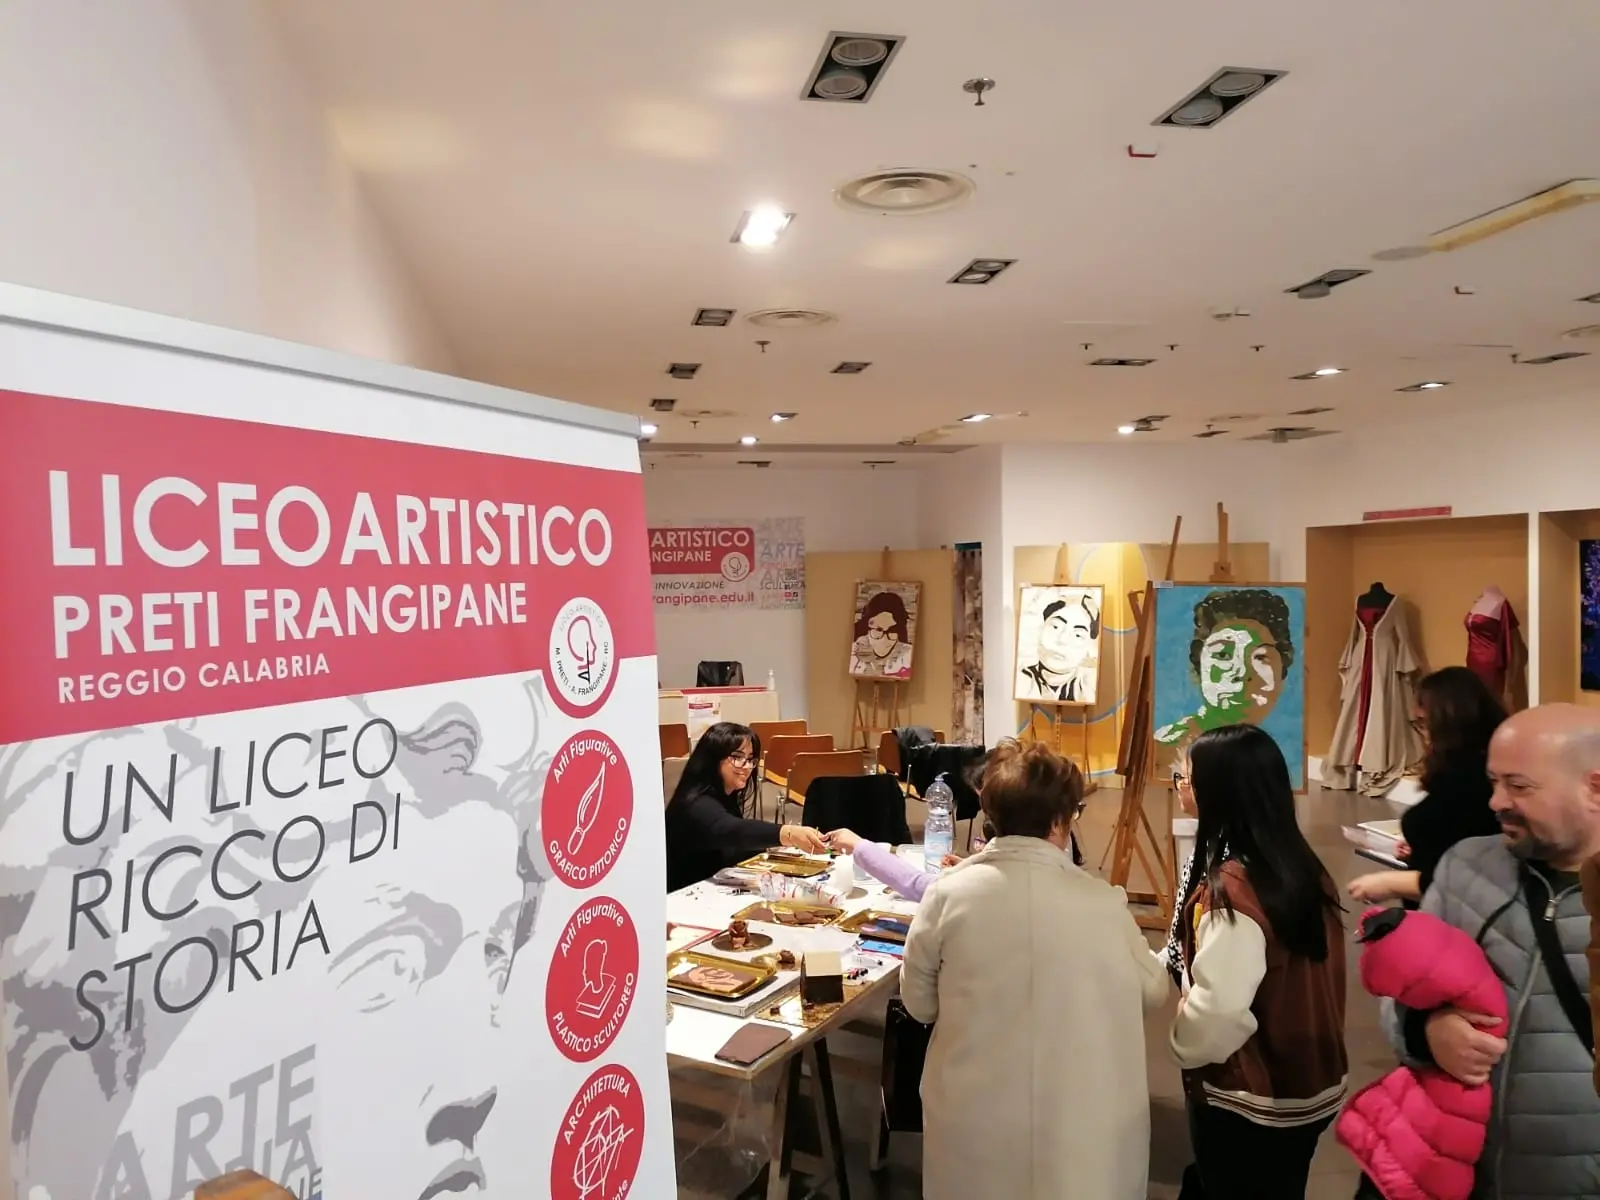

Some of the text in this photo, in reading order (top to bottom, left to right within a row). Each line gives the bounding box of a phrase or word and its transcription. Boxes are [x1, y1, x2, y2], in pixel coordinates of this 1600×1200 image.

[49, 470, 612, 568] LICEO ARTISTICO
[651, 530, 750, 547] ARTISTICO
[53, 583, 527, 659] PRETI FRANGIPANE
[655, 581, 724, 591] INNOVAZIONE
[58, 653, 330, 704] REGGIO CALABRIA
[556, 660, 569, 686] PRETI
[578, 662, 608, 695] FRANGIPANE
[62, 718, 398, 845] UN LICEO
[553, 739, 617, 783] Arti Figurative
[68, 793, 401, 951] RICCO DI
[549, 817, 627, 881] GRAFICO PITTORICO
[560, 903, 624, 957] Arti Figurative
[69, 899, 331, 1052] STORIA
[553, 972, 634, 1052] PLASTICO SCULTOREO
[92, 1043, 316, 1200] ARTE
[563, 1074, 630, 1145] ARCHITETTURA
